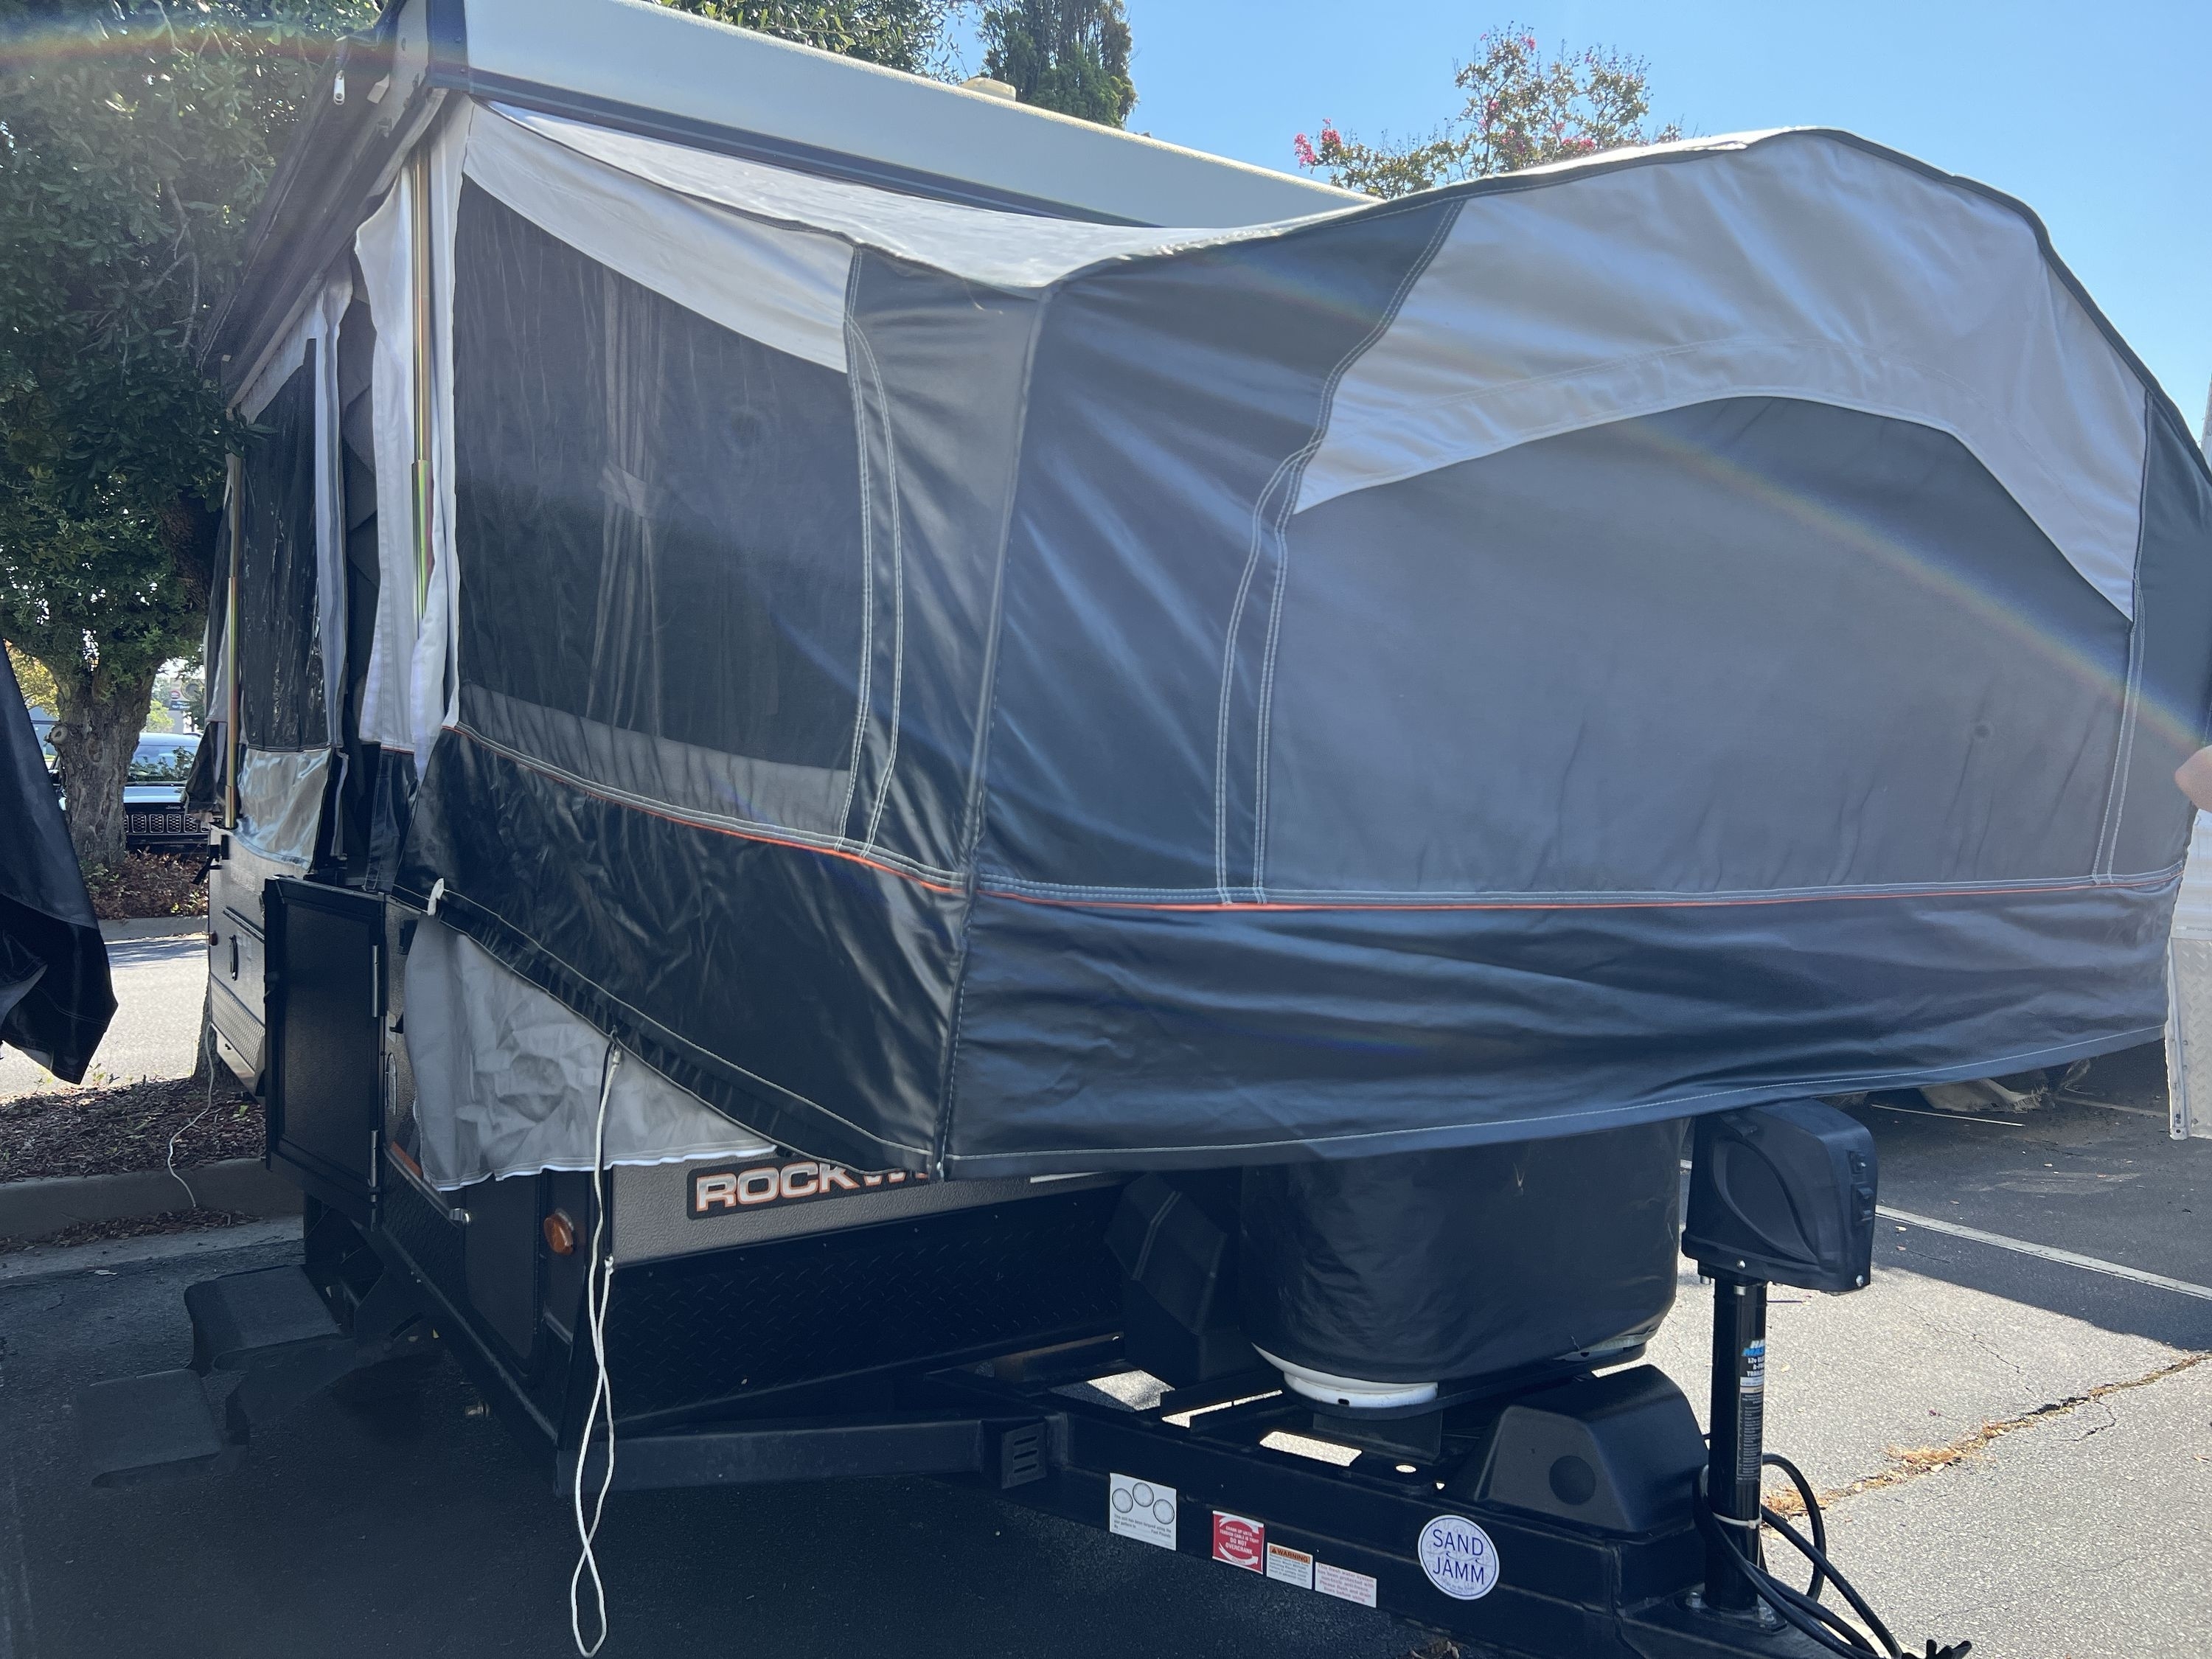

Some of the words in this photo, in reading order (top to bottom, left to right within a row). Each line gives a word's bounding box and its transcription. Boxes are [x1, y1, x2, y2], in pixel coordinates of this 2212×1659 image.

[696, 1161, 928, 1211] ROCK
[1277, 1548, 1309, 1563] WARNING
[1433, 1528, 1484, 1556] SAND
[1433, 1557, 1484, 1585] JAMM
